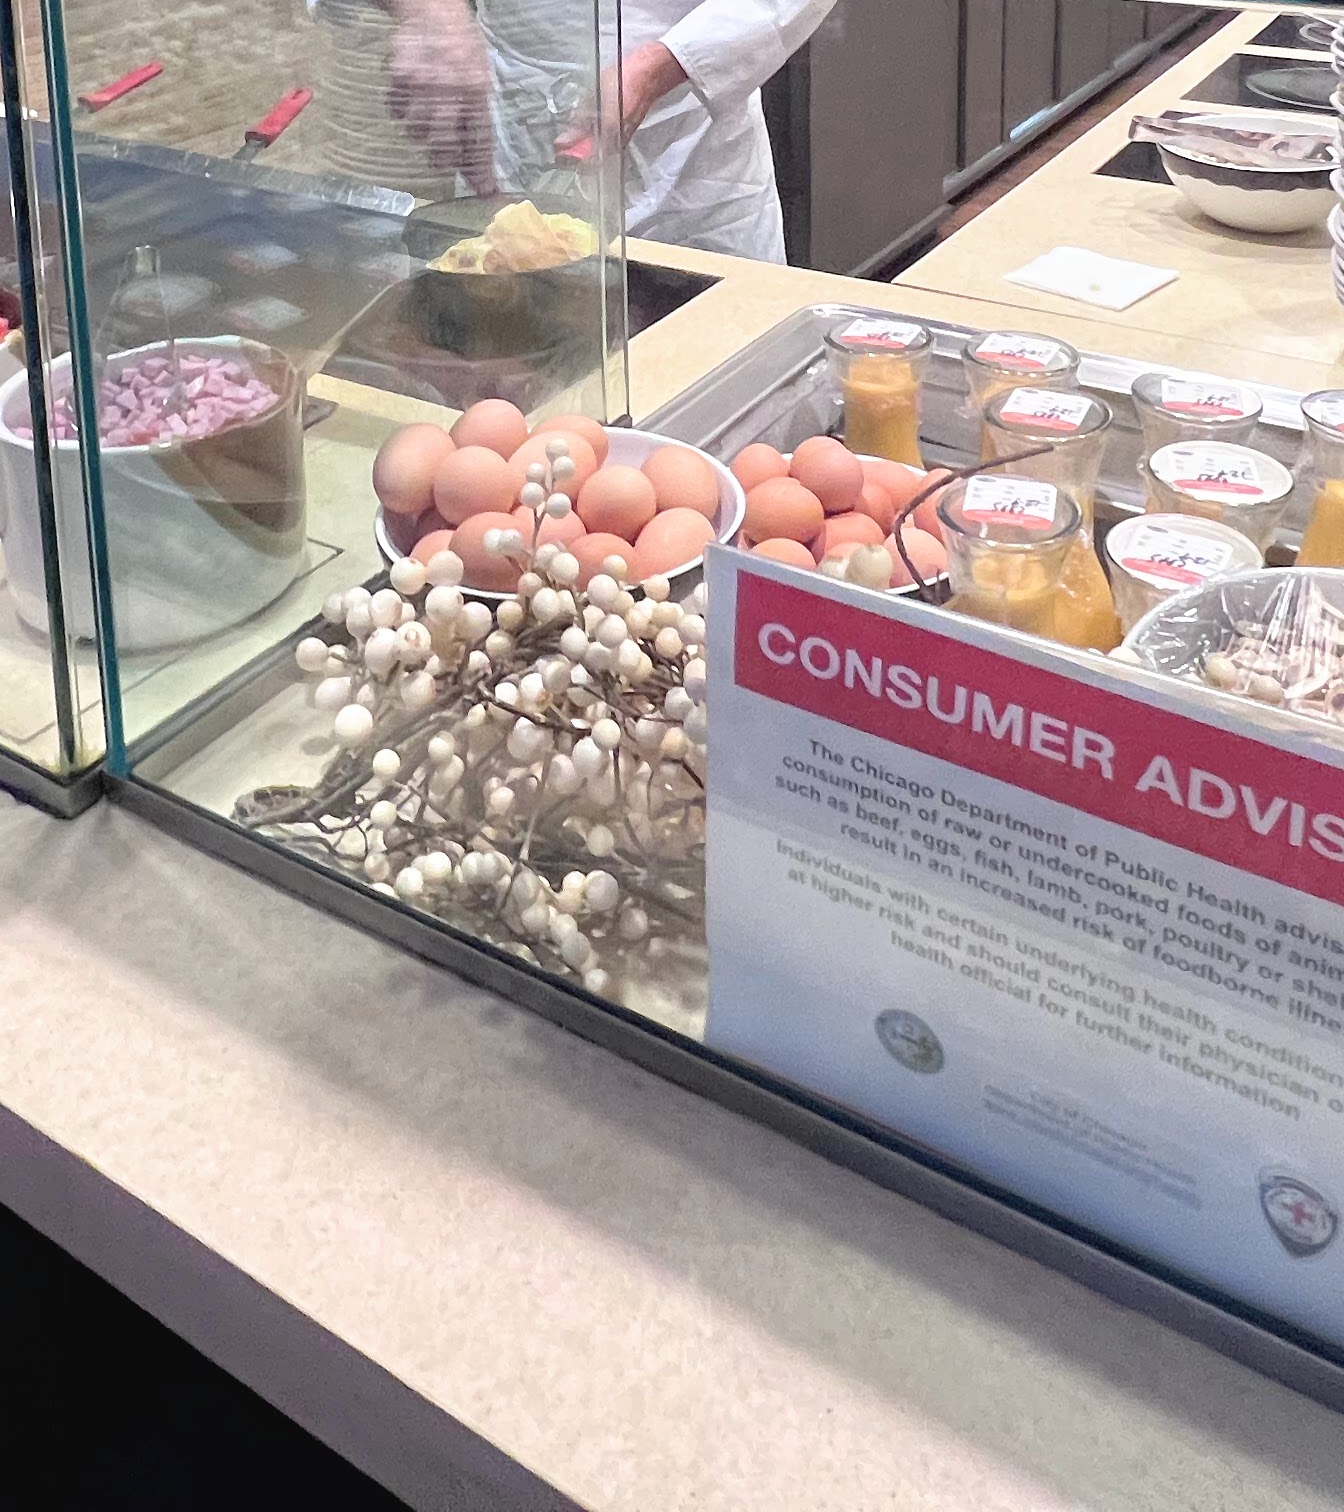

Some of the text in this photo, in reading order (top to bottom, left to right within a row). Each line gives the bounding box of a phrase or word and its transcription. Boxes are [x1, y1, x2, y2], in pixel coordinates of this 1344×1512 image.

[757, 622, 1115, 780] CONSUMER
[774, 774, 821, 803] such
[825, 795, 849, 814] as
[1161, 925, 1250, 973] poultry
[1257, 964, 1284, 983] or
[781, 755, 911, 815] consumption
[916, 807, 938, 825] of
[943, 816, 983, 841] raw
[988, 834, 1012, 853] or
[1017, 844, 1170, 915] undercooked
[1176, 903, 1246, 945] foods
[1253, 937, 1282, 956] of
[808, 738, 844, 766] The
[849, 754, 935, 799] Chicago
[939, 787, 1068, 851] Department
[1073, 843, 1098, 861] of
[1103, 848, 1178, 892] Public
[1185, 880, 1266, 926] Health
[839, 822, 897, 856] result
[902, 843, 922, 864] in
[926, 857, 953, 878] an
[959, 866, 1066, 923] increased
[1071, 915, 1114, 941] risk
[1121, 935, 1147, 955] of
[1152, 943, 1280, 1009] foodborne
[775, 838, 882, 894] Individuals
[886, 886, 930, 915] with
[935, 907, 1009, 947] certain
[1014, 938, 1136, 1003] underlying
[1142, 987, 1217, 1035] health
[787, 867, 806, 885] at
[810, 873, 874, 912] higher
[877, 905, 915, 931] risk
[921, 924, 961, 950] and
[966, 942, 1040, 984] should
[1046, 976, 1130, 1023] consult
[1137, 1012, 1191, 1047] their
[1197, 1040, 1319, 1104] physician
[890, 929, 954, 970] health
[958, 963, 1032, 1003] official
[1037, 992, 1069, 1018] for
[1074, 1009, 1152, 1054] further
